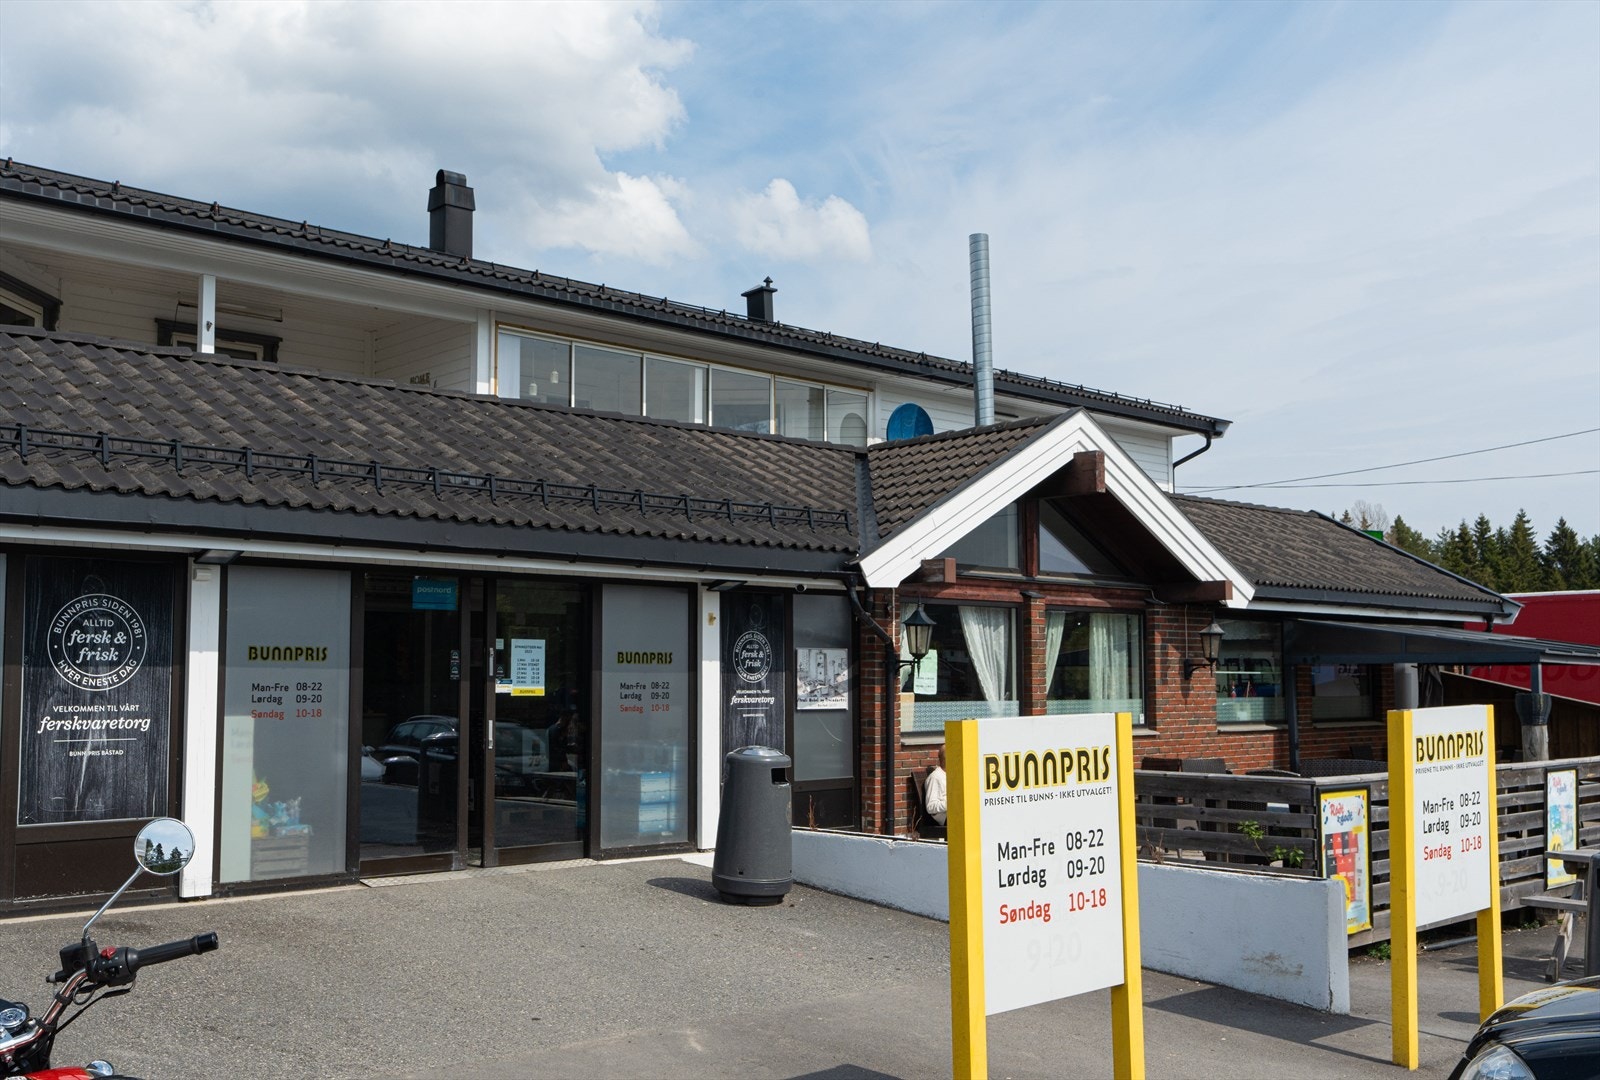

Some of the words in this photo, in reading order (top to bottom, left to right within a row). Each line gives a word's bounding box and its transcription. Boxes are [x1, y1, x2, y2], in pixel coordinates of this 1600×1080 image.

[417, 586, 452, 594] postnord
[54, 598, 98, 634] BUNNPRIS
[102, 599, 132, 619] SIDEN
[129, 618, 142, 639] 1981
[82, 619, 115, 627] ALLTID
[67, 629, 112, 647] fersk
[113, 631, 127, 644] &
[76, 647, 119, 664] frisk
[248, 646, 328, 662] BUNNPRIS
[617, 651, 673, 664] BUNNPRIS
[740, 650, 759, 659] fersk
[758, 650, 765, 658] &
[744, 660, 762, 669] frisk
[57, 659, 81, 682] HVER
[82, 674, 119, 687] ENESTE
[118, 659, 137, 678] DAG
[251, 683, 290, 692] Man-Fre
[295, 682, 323, 691] 08-22
[620, 682, 647, 690] Man-Fre
[650, 681, 670, 690] 08-22
[251, 694, 283, 706] Lørdag
[295, 694, 323, 703] 09-20
[620, 692, 642, 701] Lørdag
[650, 691, 670, 700] 09-20
[730, 695, 775, 705] ferskvaretorg
[53, 705, 105, 713] VELKOMMEN
[119, 703, 140, 712] VÅRT
[251, 709, 285, 721] Søndag
[295, 708, 322, 718] 10-18
[620, 704, 644, 714] Søndag
[651, 703, 670, 712] 10-18
[37, 715, 151, 734] ferskvaretorg
[101, 748, 124, 756] BÅSTAD
[1415, 731, 1484, 763] BUNNPRIS
[984, 746, 1110, 792] BUNNPRIS
[984, 795, 1015, 807] PRISENE
[1016, 795, 1027, 803] TIL
[1029, 792, 1054, 803] BUNNS
[1059, 789, 1075, 799] IKKE
[1076, 786, 1112, 798] UTVALGET!
[1422, 797, 1454, 814] Man-Fre
[1459, 791, 1481, 808] 08-22
[1423, 818, 1449, 835] Lørdag
[1460, 811, 1481, 828] 09-20
[997, 838, 1055, 861] Man-Fre
[1066, 828, 1104, 851] 08-22
[1423, 843, 1452, 861] Søndag
[1460, 835, 1482, 853] 10-18
[998, 865, 1047, 889] Lørdag
[1067, 856, 1105, 879] 09-20
[999, 899, 1051, 924] Søndag
[1068, 888, 1107, 912] 10-18
